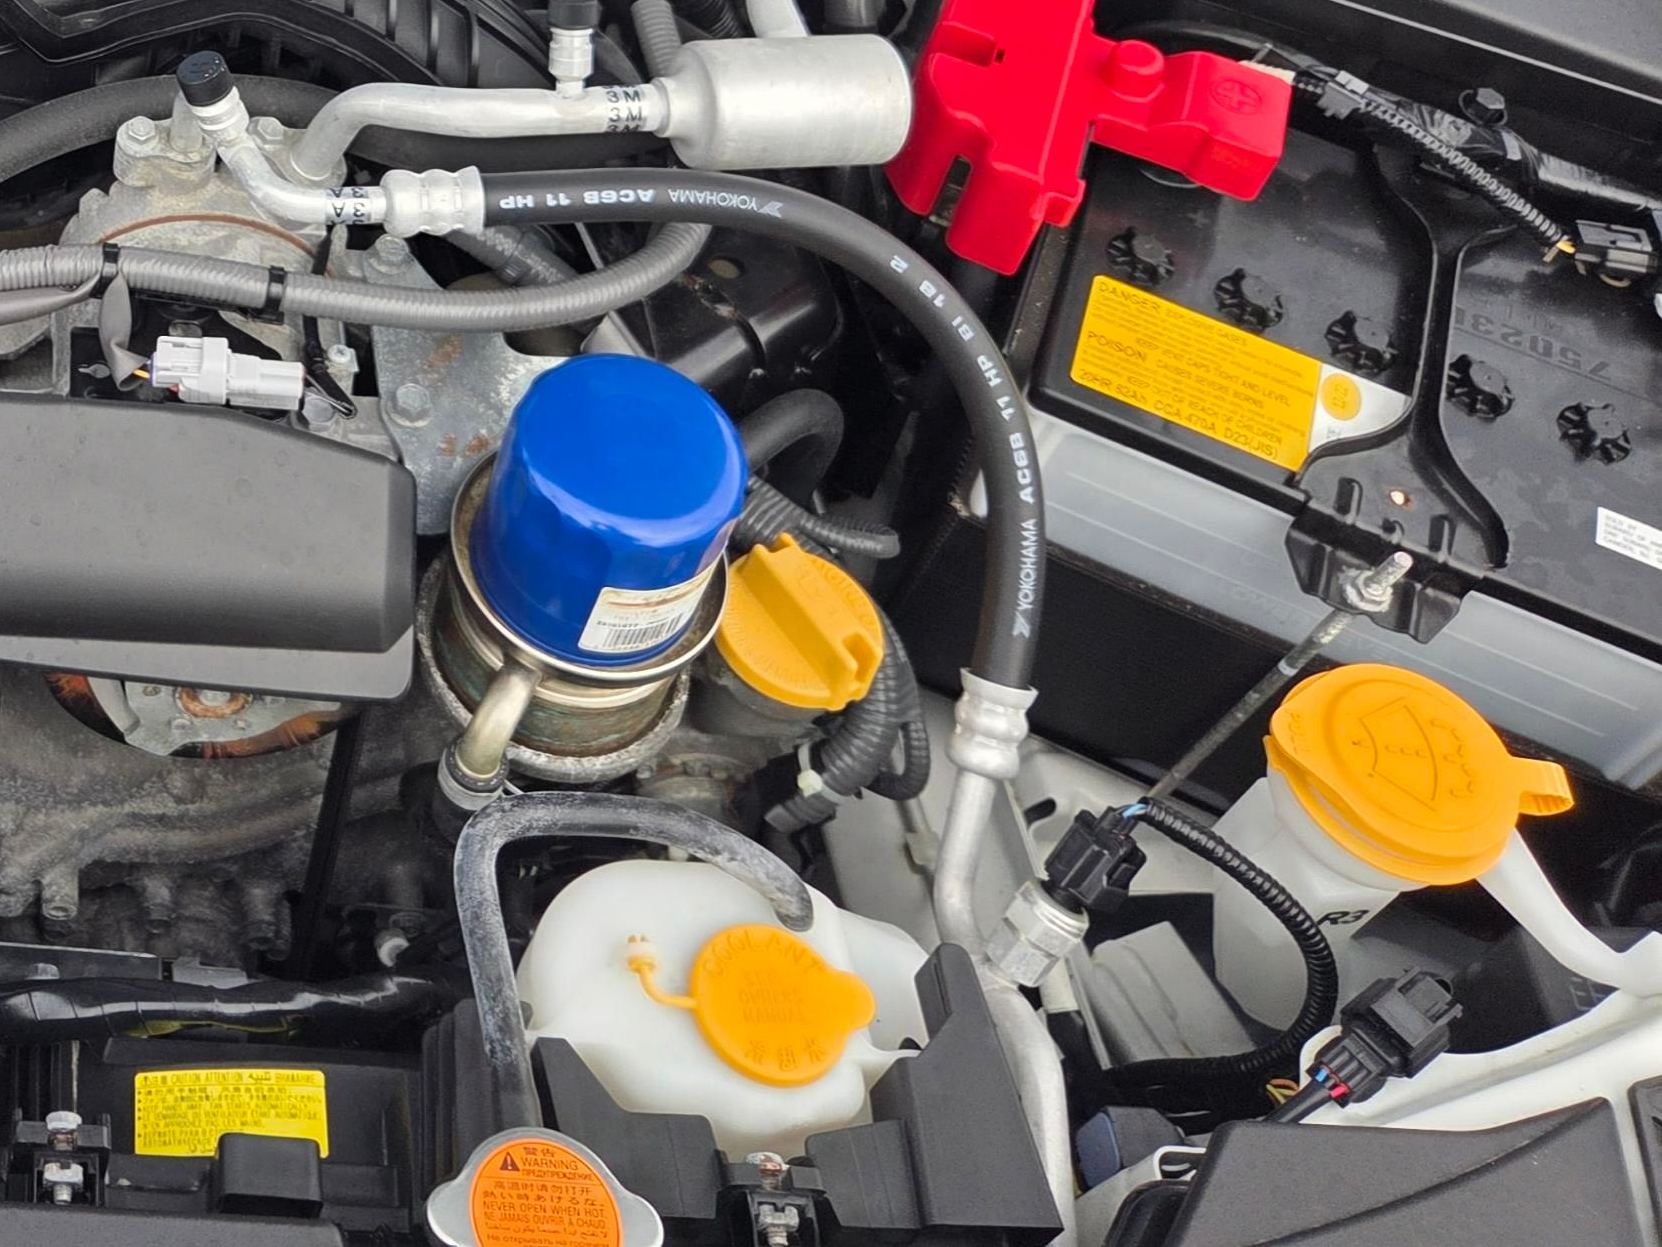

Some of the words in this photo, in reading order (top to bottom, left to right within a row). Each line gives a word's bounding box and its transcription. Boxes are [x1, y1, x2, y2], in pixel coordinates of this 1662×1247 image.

[499, 194, 534, 209] HP
[546, 193, 571, 206] 11
[583, 188, 656, 204] AC6B
[668, 188, 758, 210] YOKOHAMA
[1098, 282, 1161, 312] DANGER
[1086, 332, 1145, 360] POISON
[977, 355, 1003, 388] HP
[1241, 380, 1258, 391] AND
[996, 396, 1015, 421] 11
[1009, 432, 1034, 504] AC6B
[1017, 518, 1038, 611] YOKOHAMA
[1322, 909, 1369, 926] R3
[703, 930, 826, 977] COOLANT
[170, 1072, 201, 1084] CAUTION
[520, 1156, 579, 1171] WARNING
[483, 1200, 516, 1212] NEVER
[520, 1203, 547, 1214] OPEN
[551, 1205, 581, 1217] WHEN
[484, 1211, 497, 1221] NE
